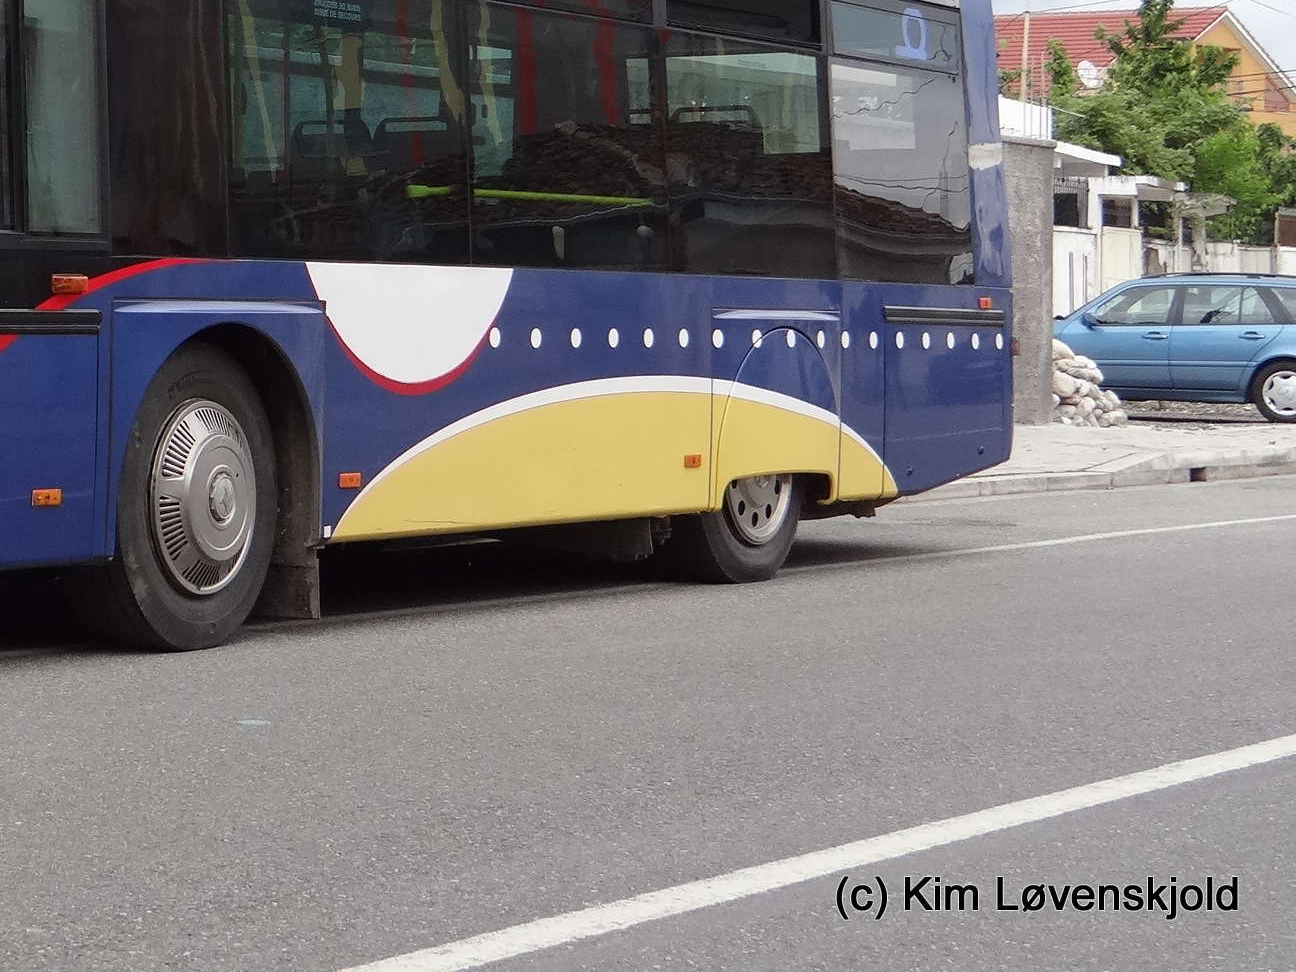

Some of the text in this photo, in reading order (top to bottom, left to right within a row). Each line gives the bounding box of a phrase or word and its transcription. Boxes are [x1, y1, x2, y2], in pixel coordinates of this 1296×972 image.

[314, 8, 362, 21] ISSUE DE SECOURS
